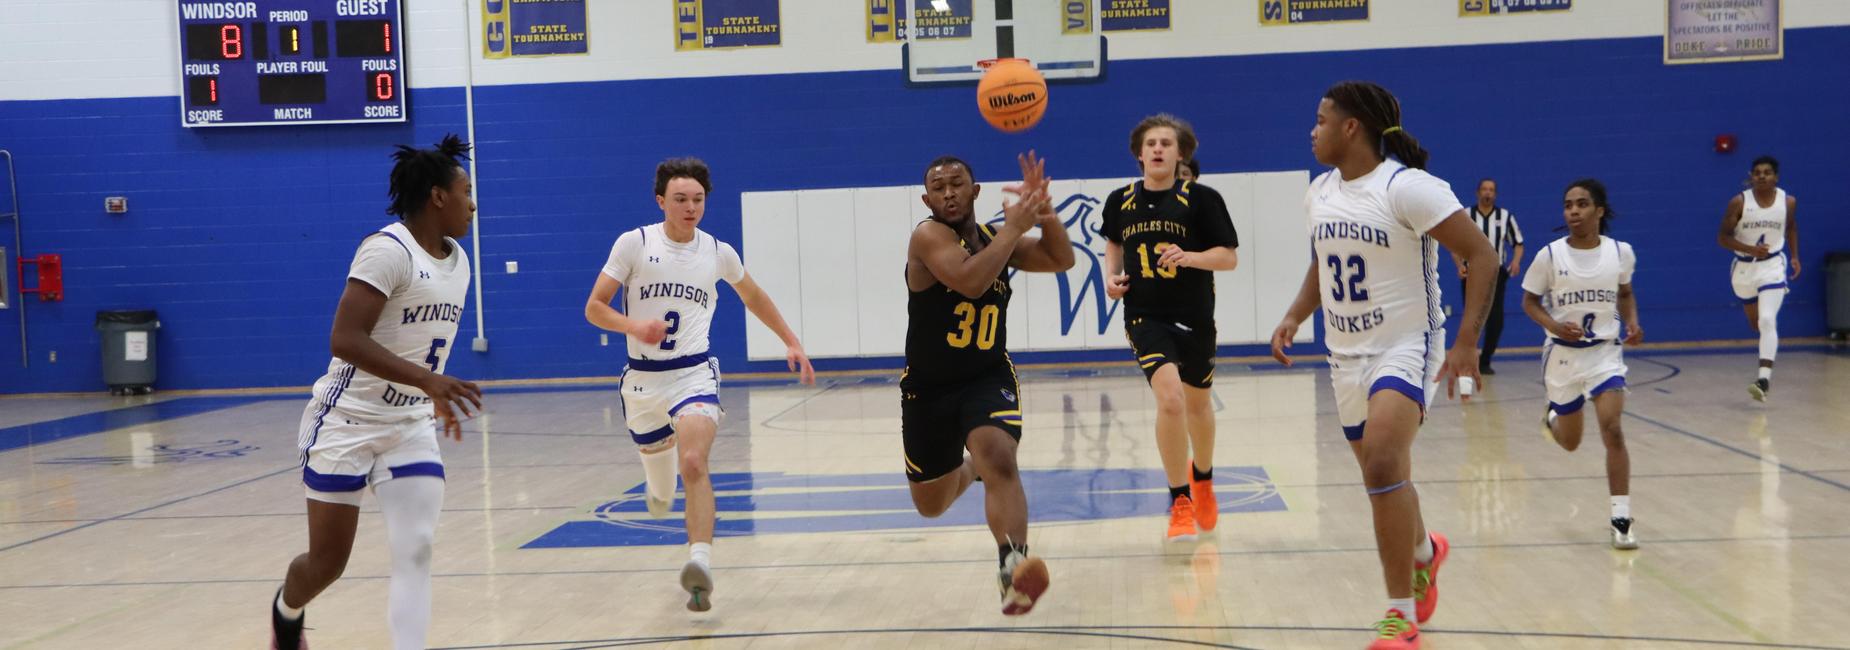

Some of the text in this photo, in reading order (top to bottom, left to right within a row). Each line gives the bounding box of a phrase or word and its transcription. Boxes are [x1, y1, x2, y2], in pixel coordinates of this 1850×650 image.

[182, 3, 257, 19] WINDSOR
[336, 0, 388, 16] GUEST
[1112, 0, 1149, 9] STATE
[1264, 1, 1282, 20] S
[1291, 0, 1365, 10] TOURNAMENT
[269, 11, 308, 22] PERIOD
[1101, 8, 1167, 18] OURNAMENT
[1291, 11, 1303, 20] 04
[1707, 11, 1738, 21] LET THE
[679, 0, 697, 47] TE
[723, 17, 760, 26] STATE
[898, 16, 970, 27] TRNAMENT
[1723, 24, 1732, 33] BE
[1735, 23, 1771, 32] POSITIVE
[530, 25, 567, 33] STATE
[706, 25, 778, 35] TOURNAMENT
[928, 27, 939, 36] 06
[943, 27, 955, 36] 07
[221, 25, 241, 58] 8
[293, 29, 299, 51] 1
[383, 23, 390, 52] 1
[513, 33, 584, 43] TOURNAMENT
[1675, 38, 1770, 52] DUKE PRIDE
[185, 64, 220, 75] FOULS
[257, 61, 328, 74] PLAYER FOUL
[362, 59, 396, 71] FOULS
[210, 80, 216, 102] 1
[376, 73, 392, 100] 0
[989, 92, 1036, 110] Wilson
[188, 110, 223, 121] SCORE
[274, 108, 312, 120] MATCH
[365, 106, 399, 118] SCORE
[1122, 220, 1187, 240] CHARLES CITY
[1327, 254, 1369, 302] 32
[640, 282, 709, 309] WINDSOR
[946, 301, 1000, 350] 30
[1327, 307, 1384, 333] DUKES
[660, 310, 680, 350] 2
[425, 338, 447, 372] 5
